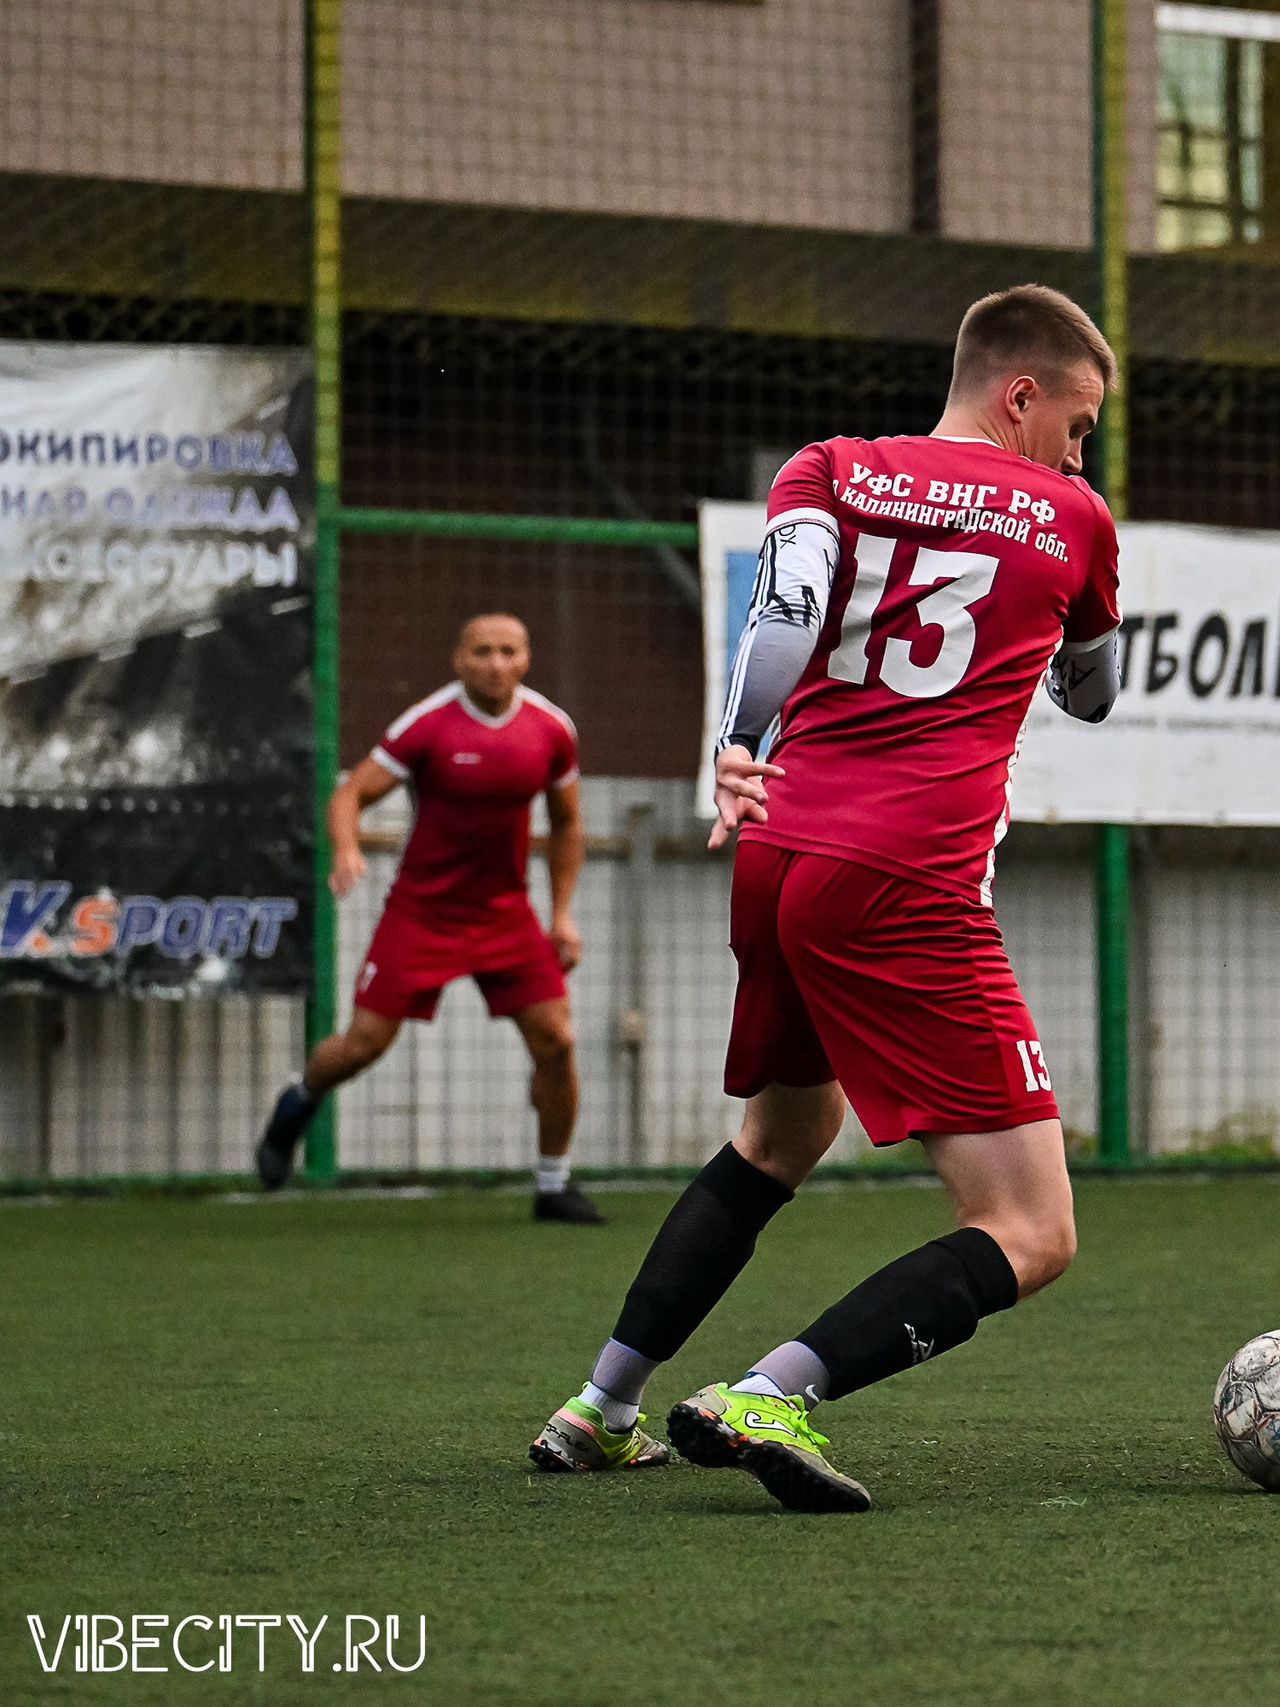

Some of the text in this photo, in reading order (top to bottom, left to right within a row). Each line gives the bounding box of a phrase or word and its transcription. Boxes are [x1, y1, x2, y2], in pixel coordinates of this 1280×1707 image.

[840, 486, 1031, 544] КАЛИНИНГРАДСКОЙ
[849, 462, 914, 496] УФС
[925, 480, 997, 508] ВНГ
[1008, 489, 1056, 525] РФ
[5, 537, 298, 587] КСЕССУАРЫ
[827, 532, 1000, 699] 13
[1016, 1040, 1051, 1092] 13
